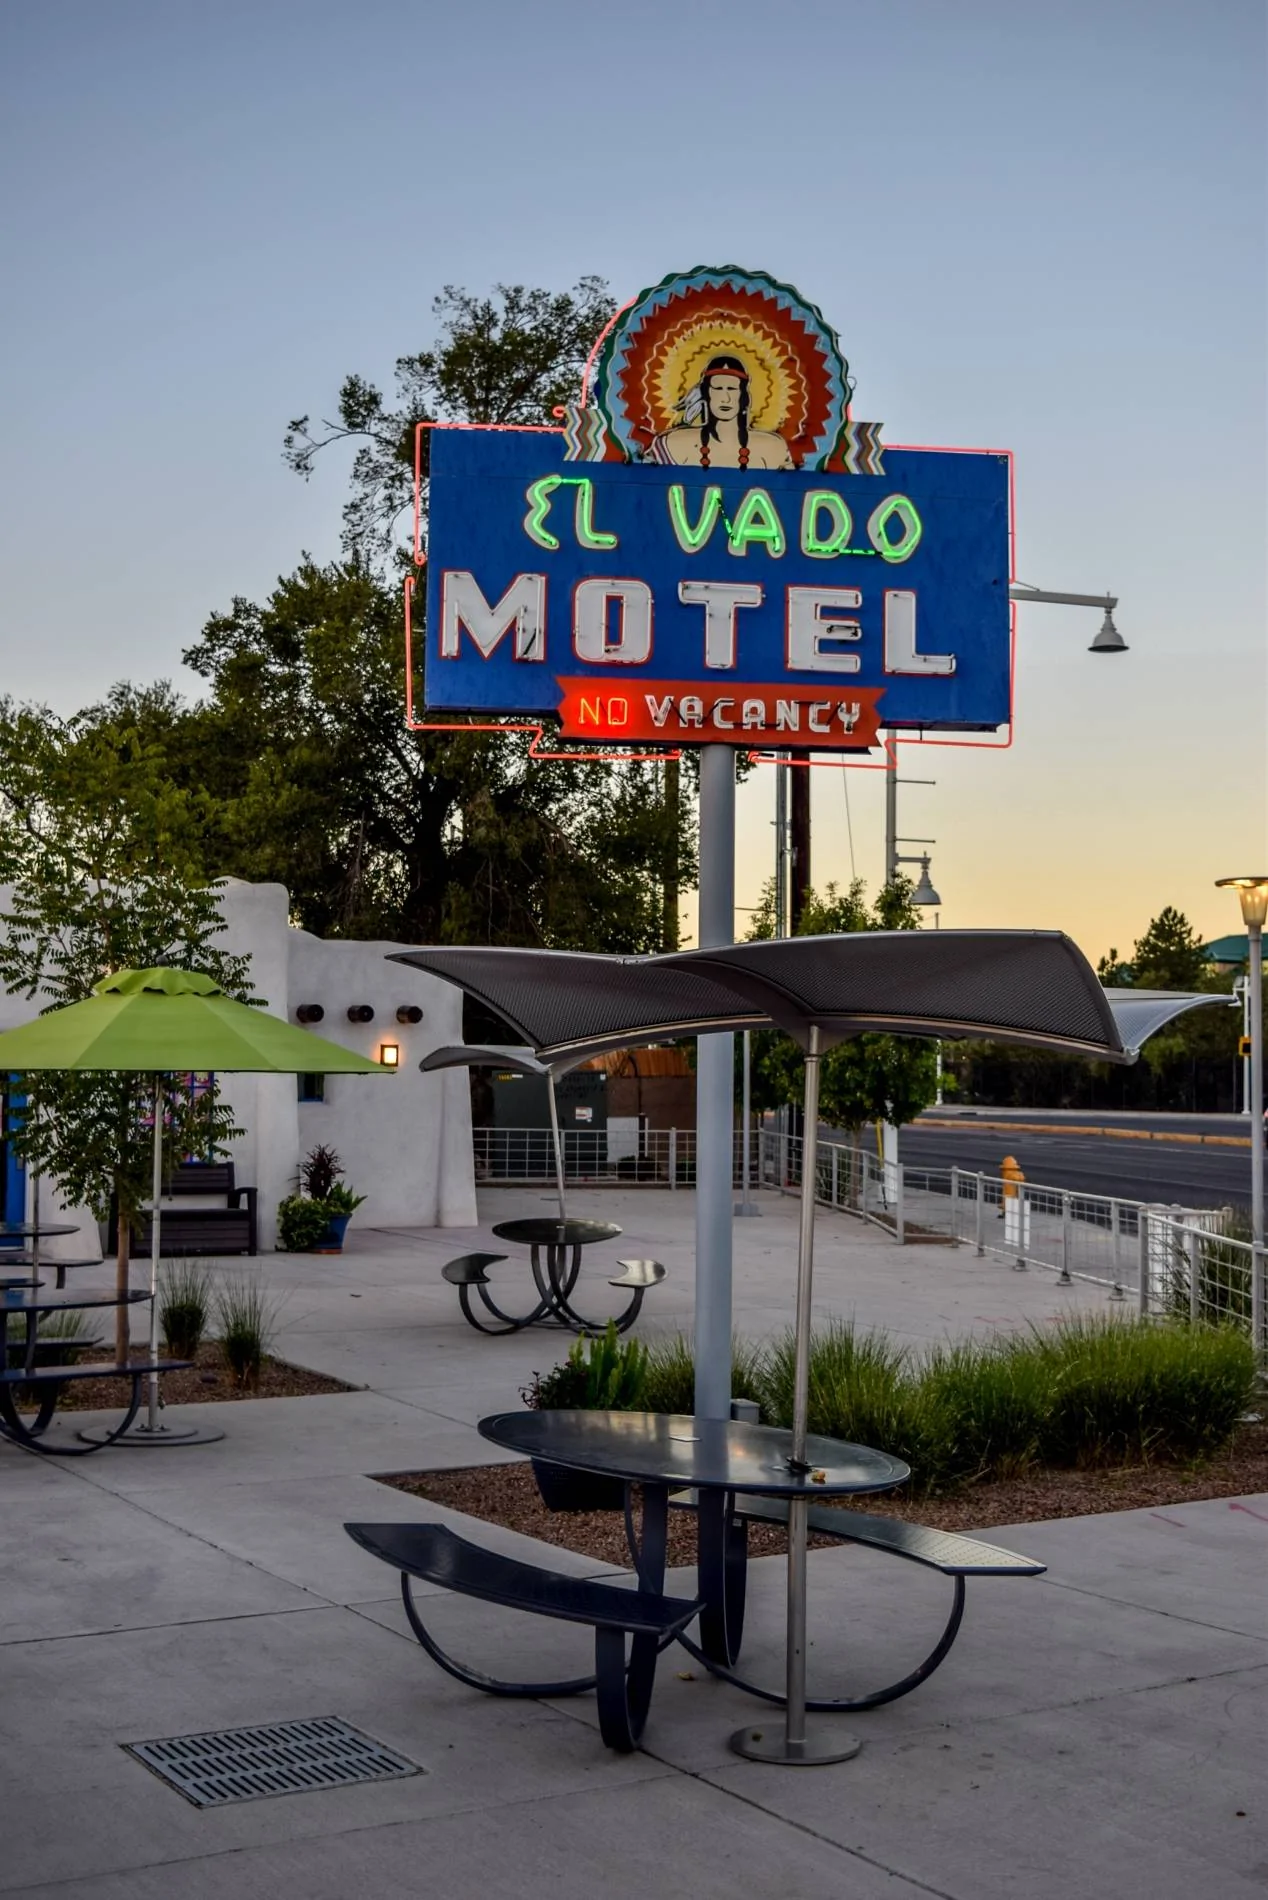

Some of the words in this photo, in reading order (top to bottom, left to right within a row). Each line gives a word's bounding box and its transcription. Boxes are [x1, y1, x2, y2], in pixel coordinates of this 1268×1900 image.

[524, 474, 618, 550] EL
[668, 485, 923, 562] VADO
[440, 570, 957, 675] MOTEL
[578, 696, 628, 726] NO
[644, 694, 861, 734] VACANCY
